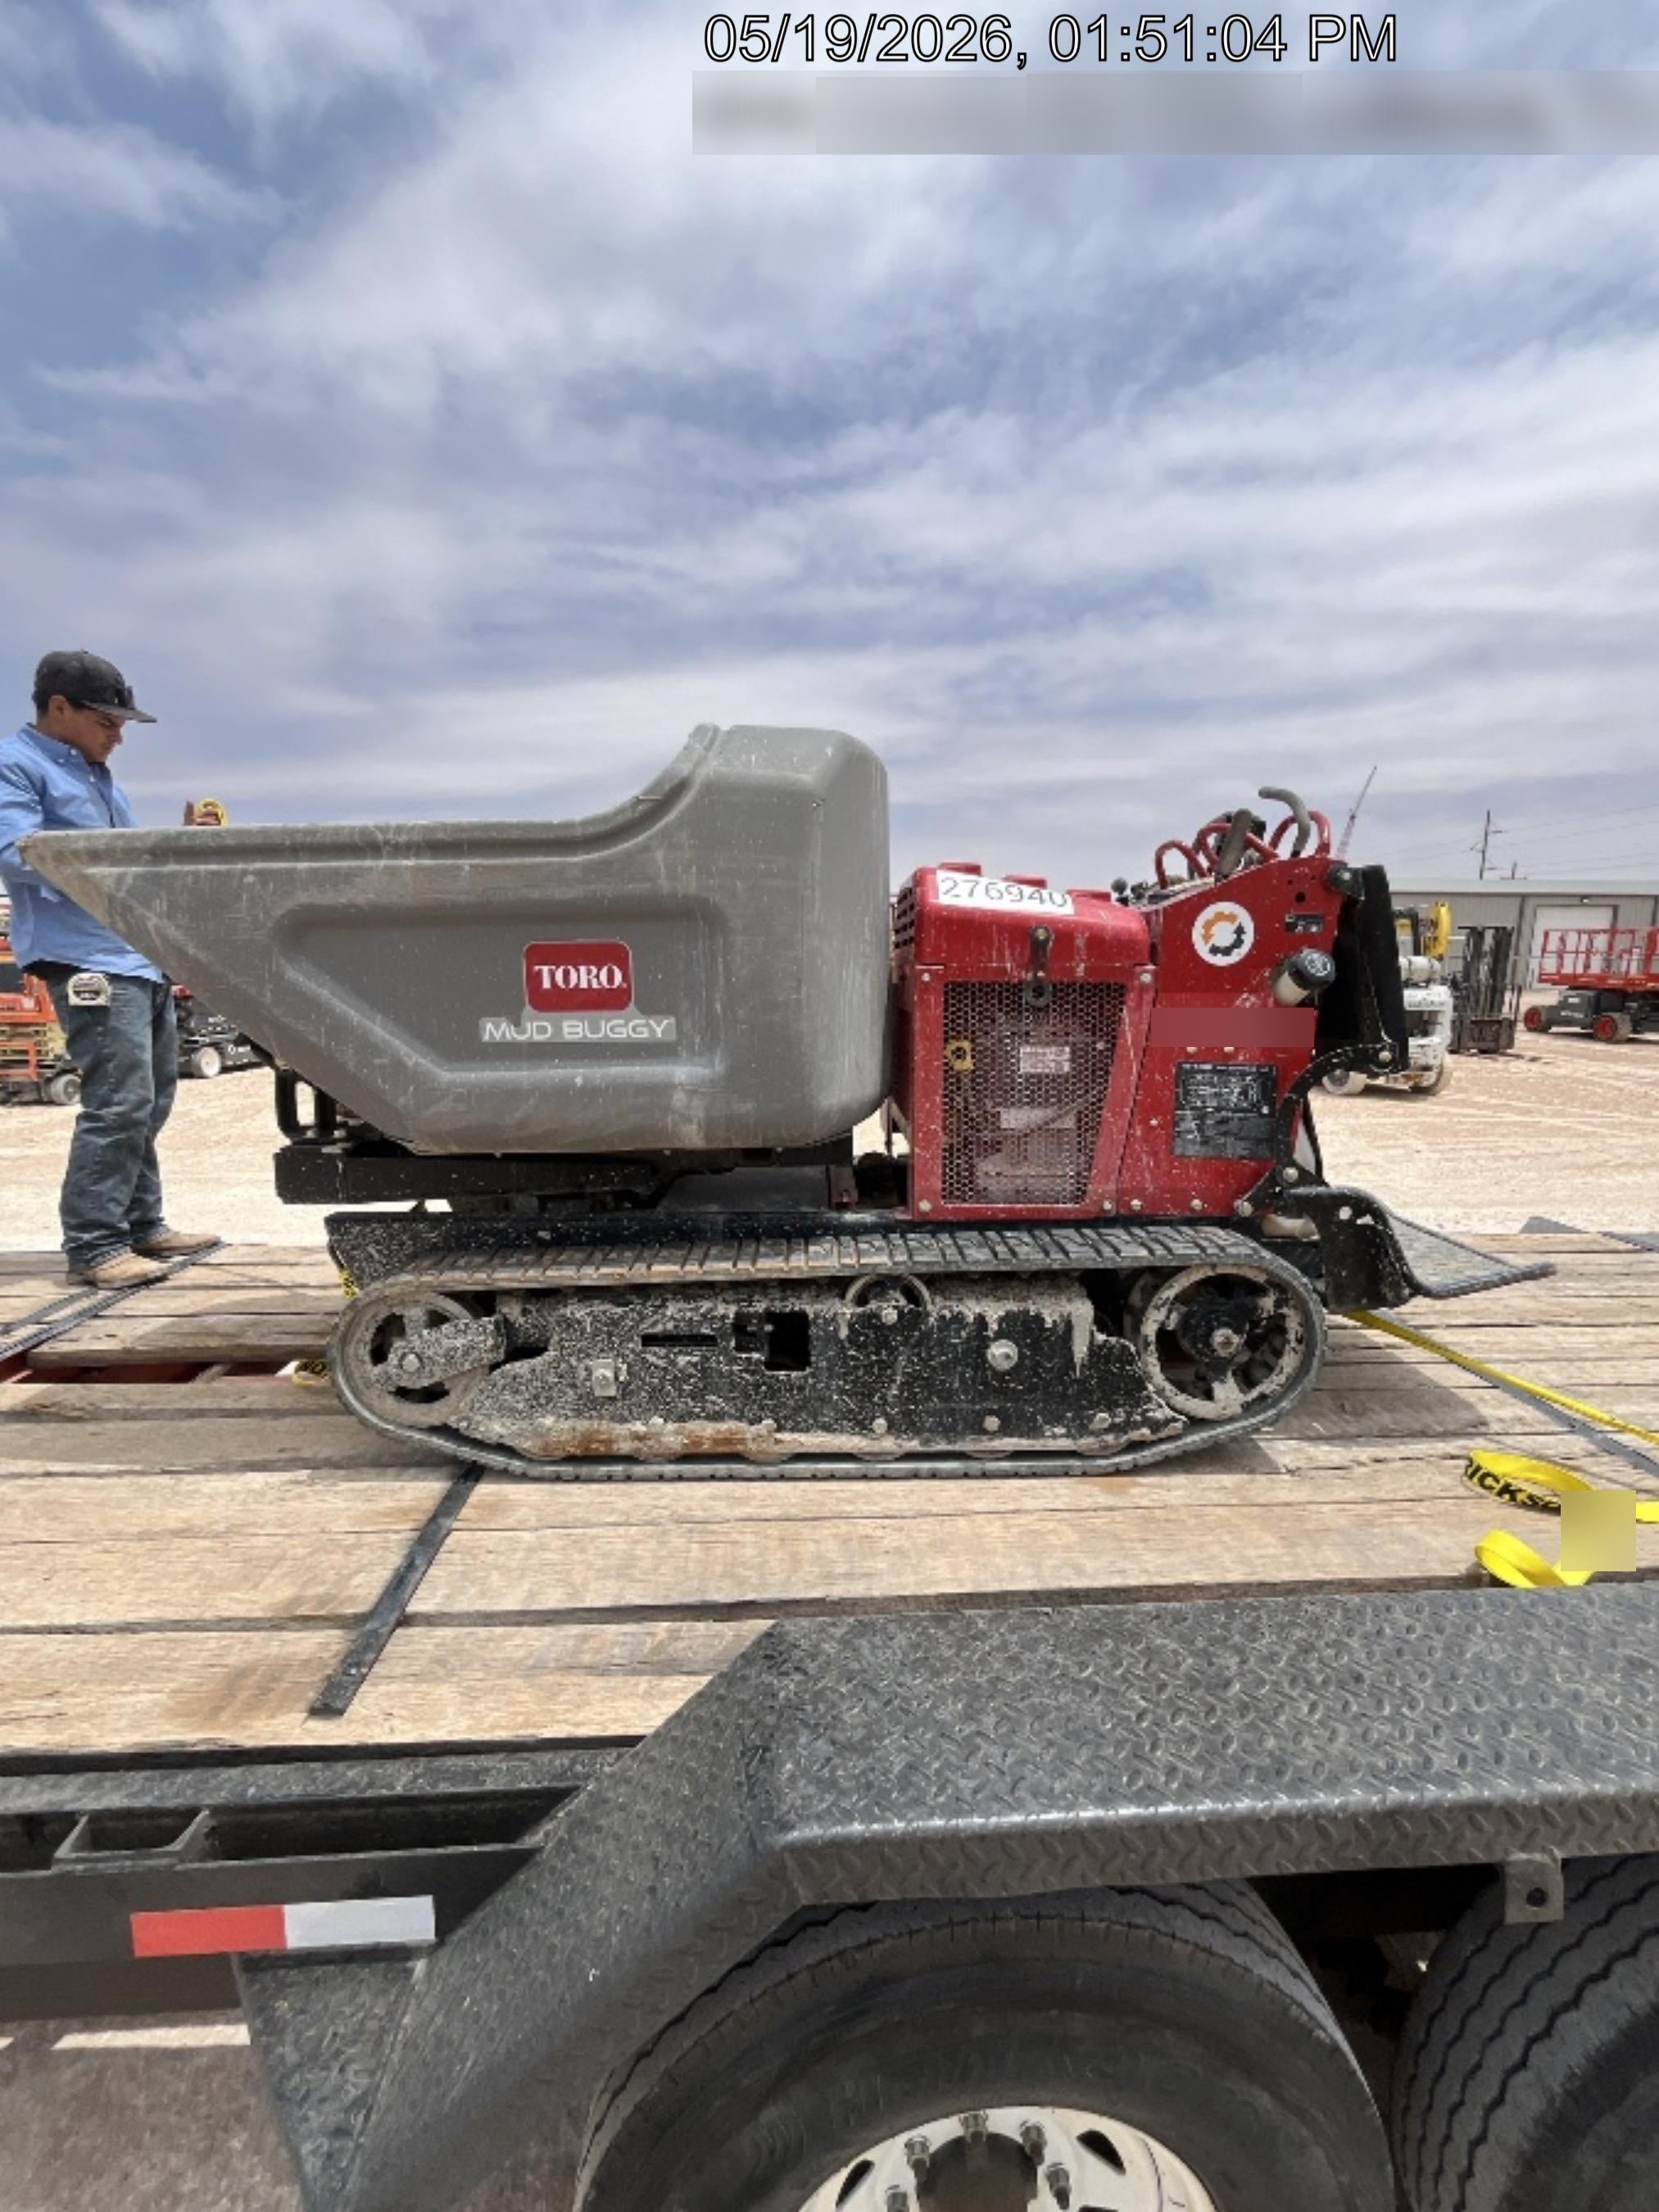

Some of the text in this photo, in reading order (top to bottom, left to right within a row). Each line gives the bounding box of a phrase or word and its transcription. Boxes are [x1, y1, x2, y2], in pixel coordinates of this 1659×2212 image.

[534, 964, 624, 990] TORO
[484, 1019, 670, 1040] MUD BUGGY
